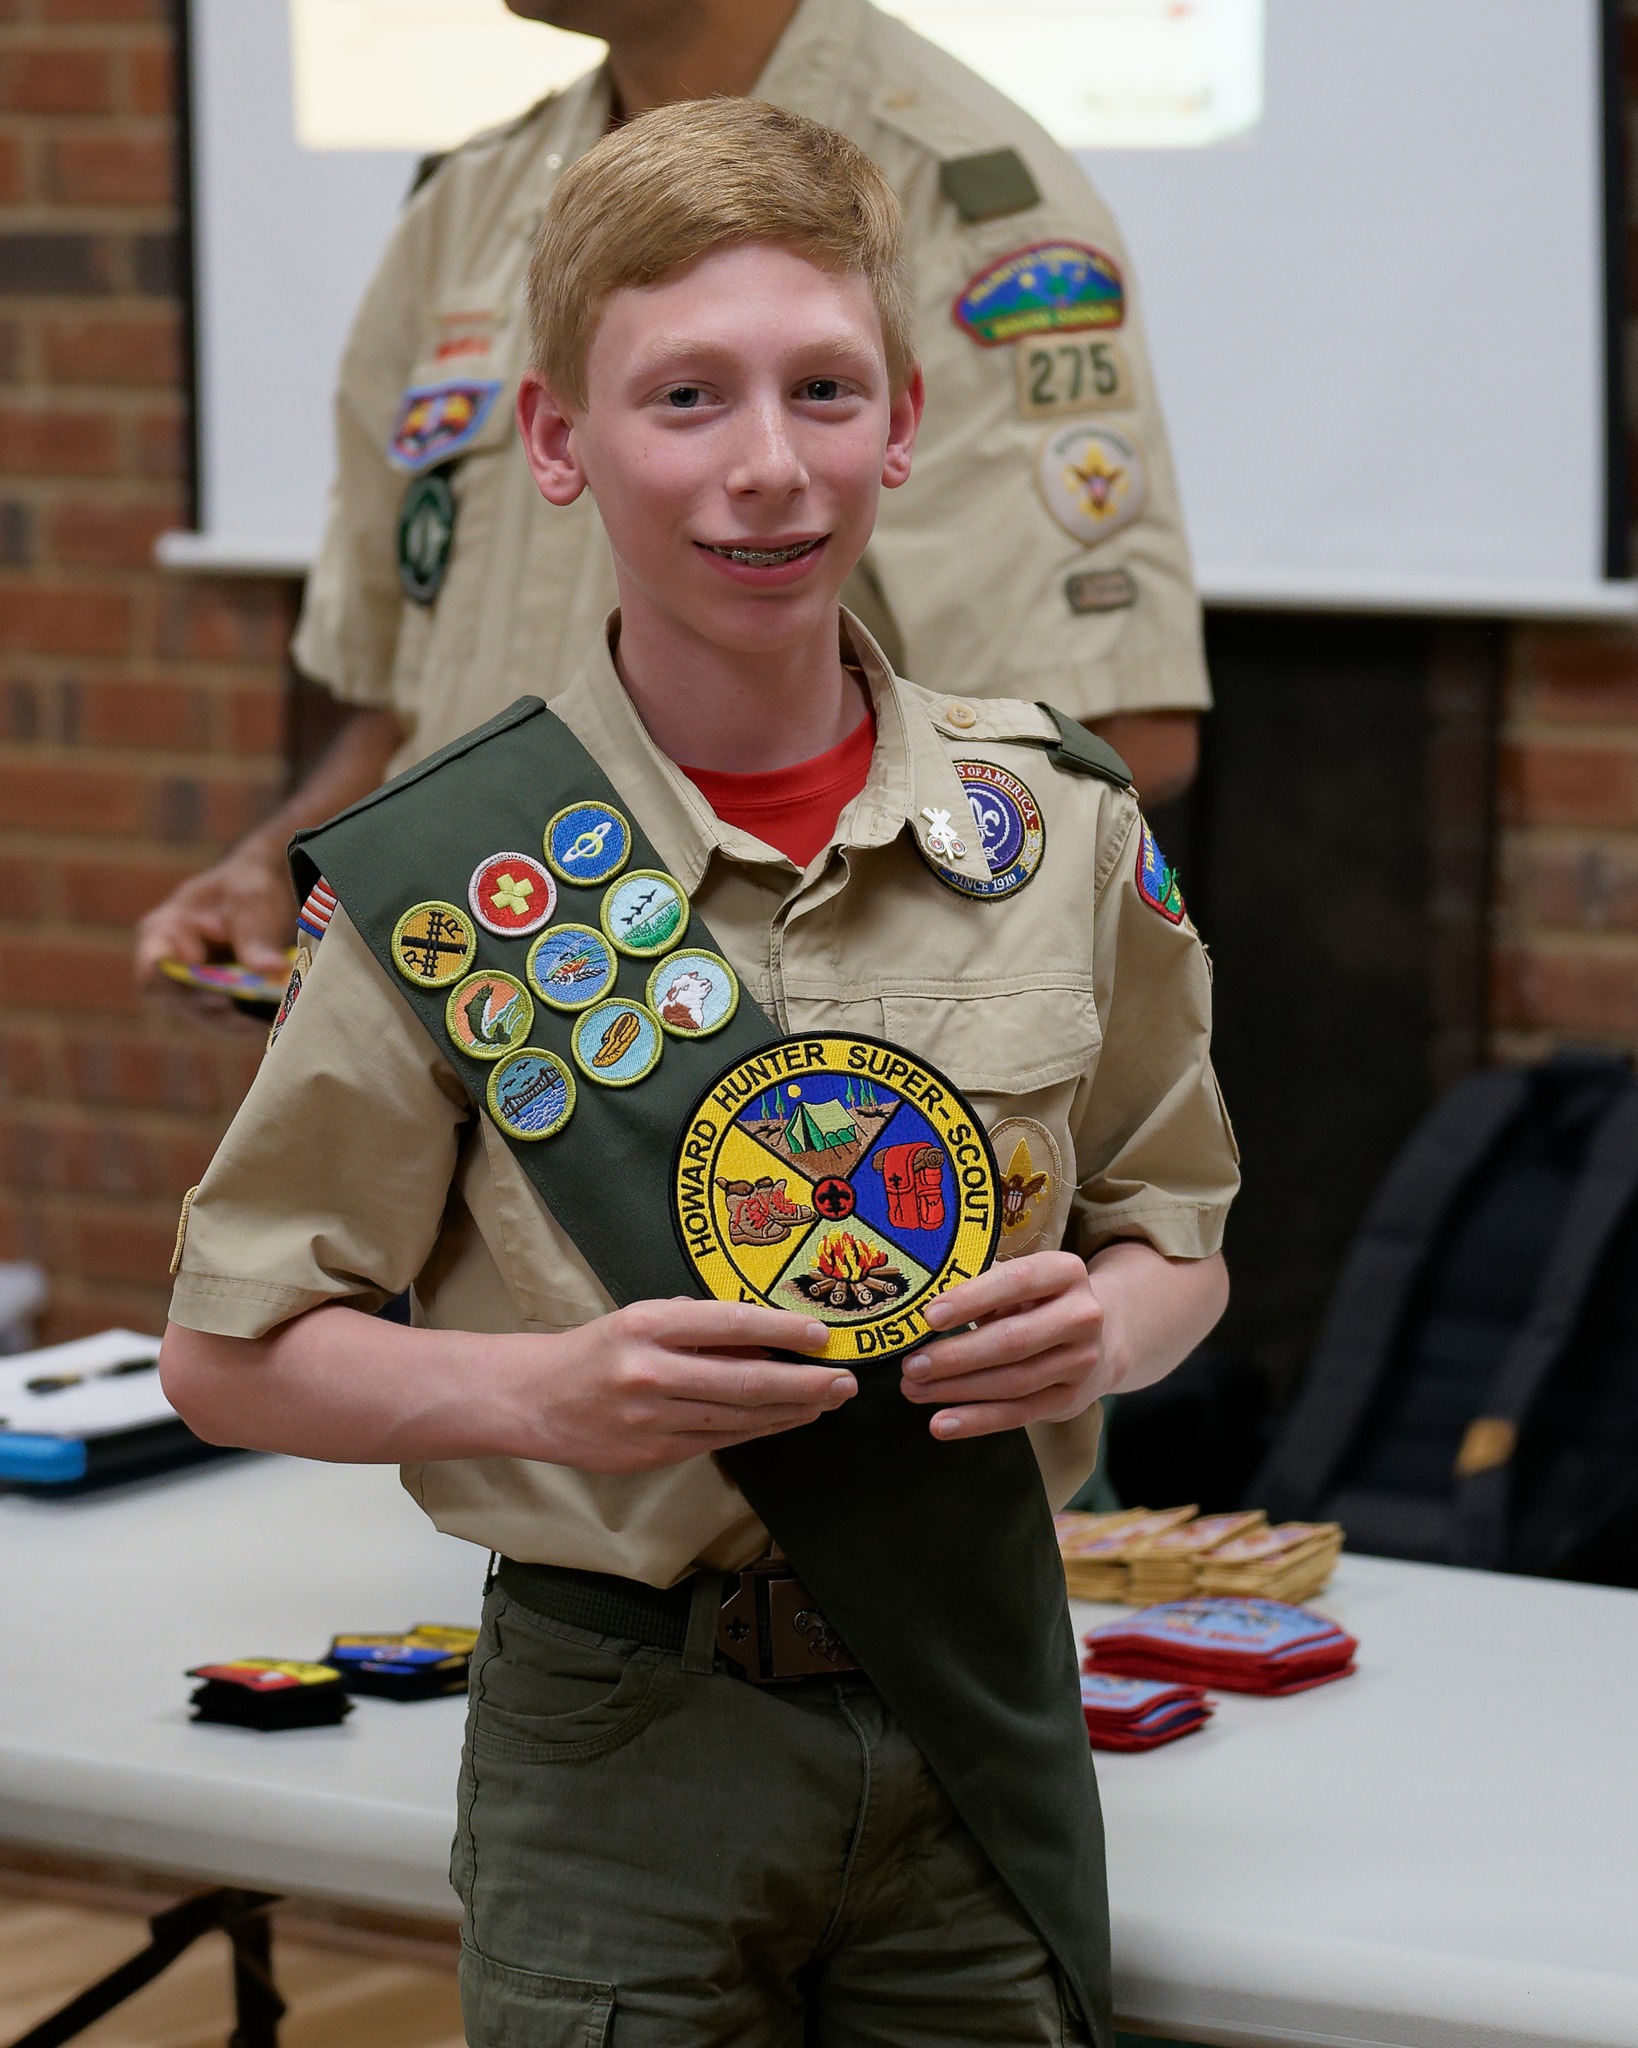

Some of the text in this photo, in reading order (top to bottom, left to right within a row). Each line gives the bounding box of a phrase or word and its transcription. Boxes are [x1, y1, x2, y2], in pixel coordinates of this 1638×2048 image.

[1029, 342, 1119, 405] 275
[967, 766, 982, 776] OF
[984, 769, 1036, 820] AMERICA
[951, 873, 1017, 892] SINCE 1910
[681, 1119, 717, 1258] HOWARD
[712, 1042, 827, 1112] HUNTER
[855, 1258, 972, 1354] DISTT
